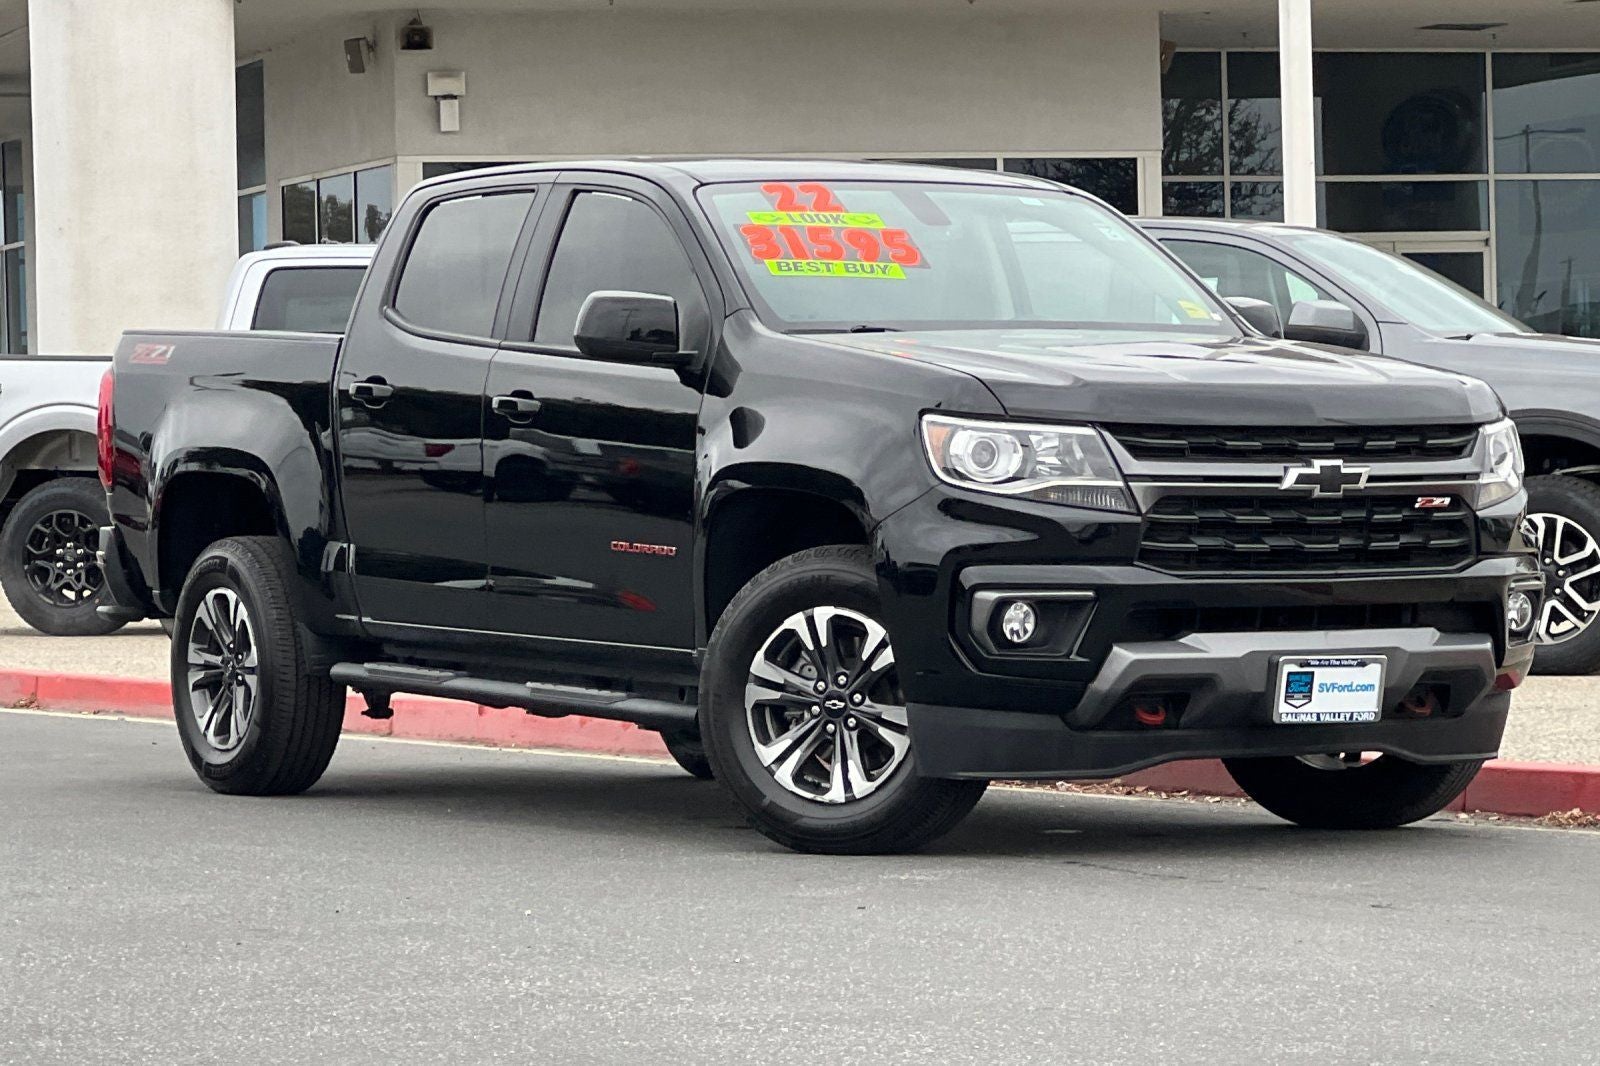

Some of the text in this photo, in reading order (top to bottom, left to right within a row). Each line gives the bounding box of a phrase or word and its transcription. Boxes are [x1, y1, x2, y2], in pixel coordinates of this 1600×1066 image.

[760, 182, 845, 213] 22
[785, 213, 847, 225] LOOK
[739, 223, 921, 266] 31595
[775, 261, 891, 275] BEST BUY
[128, 343, 176, 365] Z71
[611, 541, 676, 556] COLORADO
[1317, 681, 1376, 693] SVFord.com
[1281, 711, 1376, 722] SALINAS VALLEY FORD
